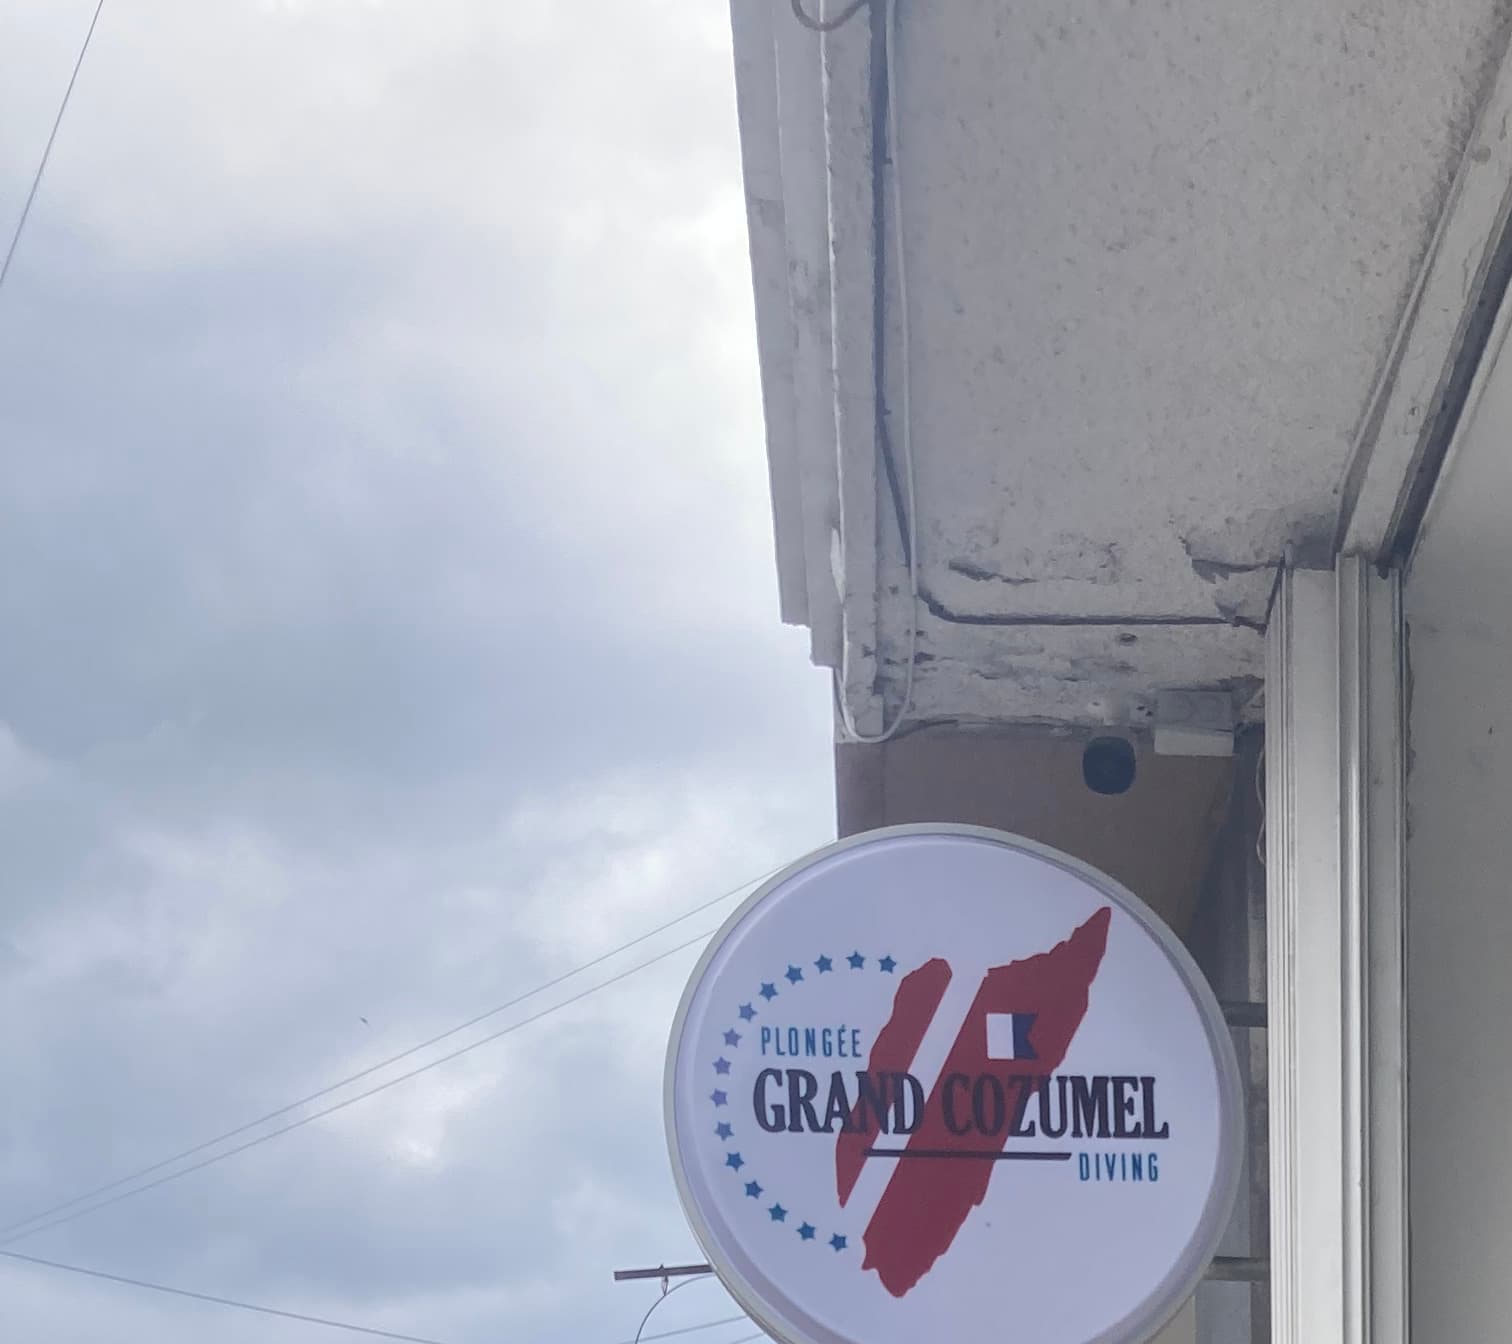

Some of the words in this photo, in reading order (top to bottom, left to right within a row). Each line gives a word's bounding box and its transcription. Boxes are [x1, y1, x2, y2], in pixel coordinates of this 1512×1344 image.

[761, 1024, 862, 1058] PLONGÉE
[753, 1067, 925, 1135] GRAND
[942, 1072, 1169, 1139] COZUMEL
[1079, 1152, 1158, 1182] DIVING
